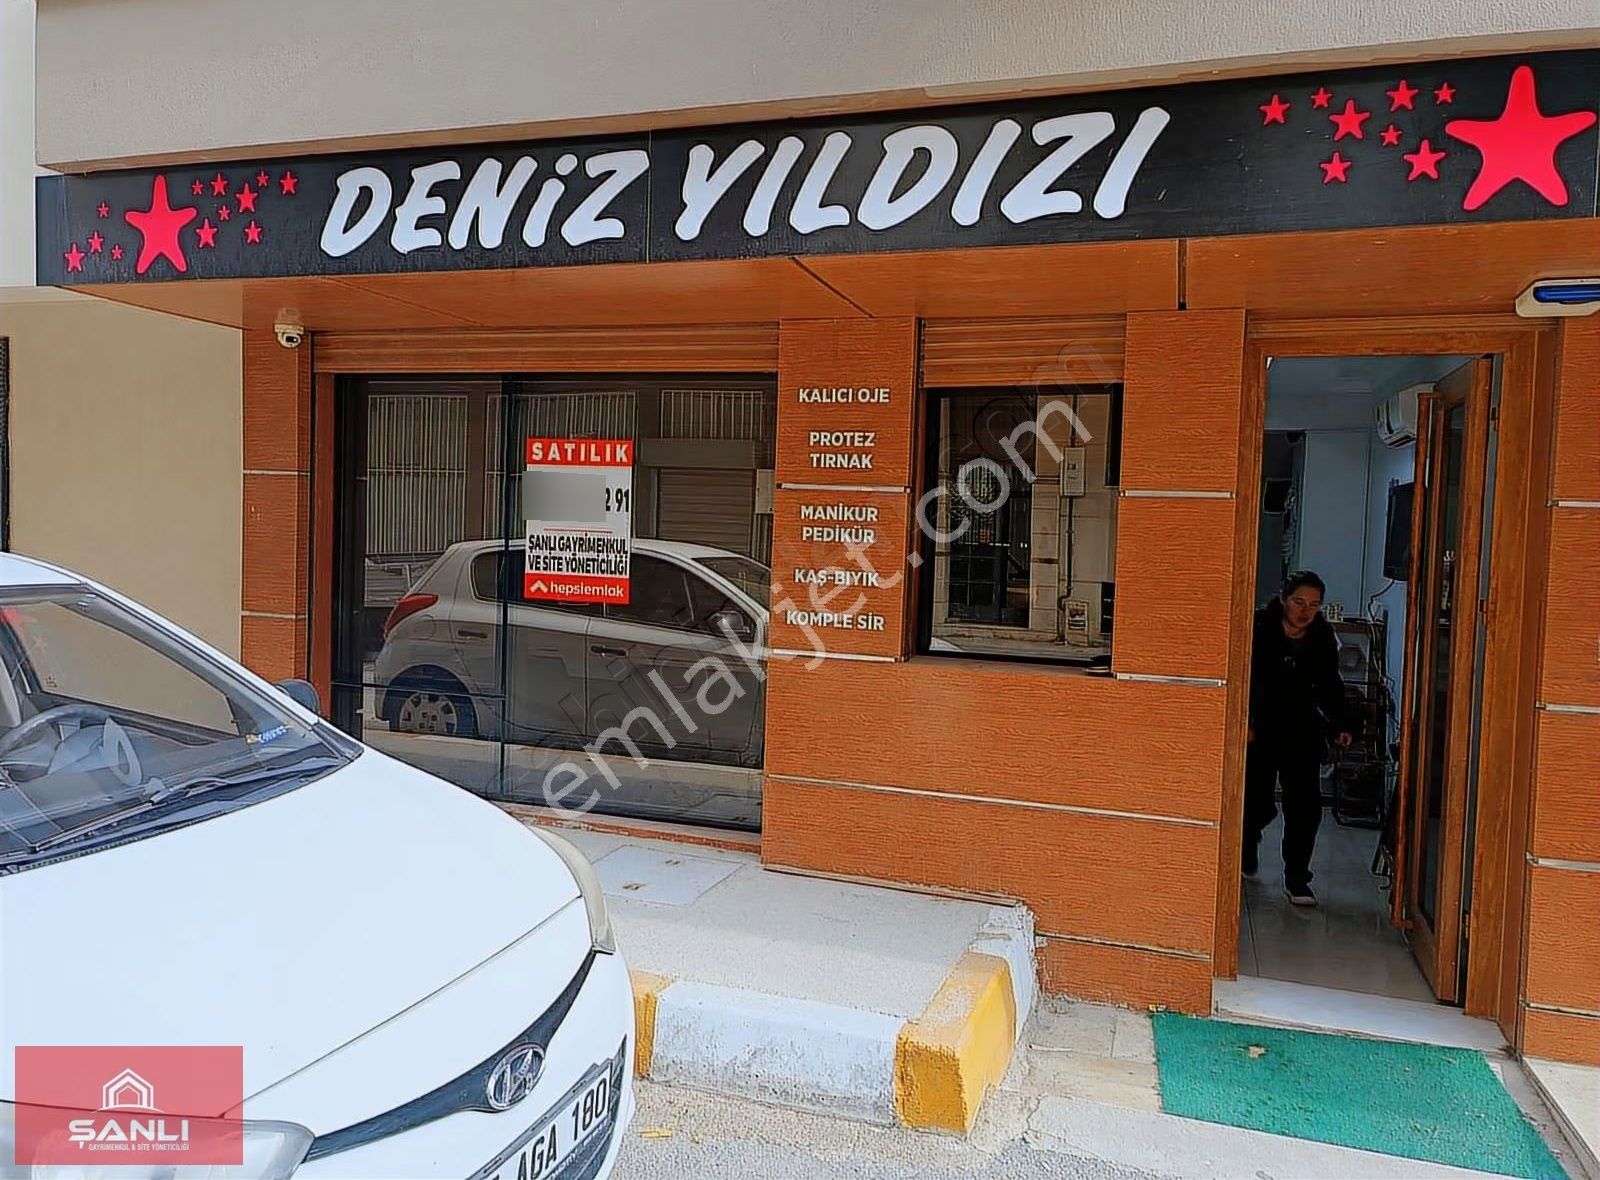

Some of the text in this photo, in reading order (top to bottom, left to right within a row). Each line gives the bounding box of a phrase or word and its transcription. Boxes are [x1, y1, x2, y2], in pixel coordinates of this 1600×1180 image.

[674, 106, 1170, 240] YILDIZI
[799, 388, 890, 403] KALICI OJE
[809, 431, 875, 447] PROTEZ
[532, 442, 628, 462] SATILIK
[810, 453, 873, 469] TIRNAK
[615, 488, 629, 512] 91
[801, 503, 878, 521] MANİKUR
[529, 533, 628, 554] ŞANLI GAYRİMENKUL
[802, 525, 875, 543] PEDİKÜR
[528, 552, 627, 575] VE SİTE YÖNETİCİLİĞİ
[795, 568, 879, 586] KAŞ-BIYIK
[551, 581, 624, 597] hepsiemlak
[786, 610, 884, 630] KOMPLE SİR
[517, 1124, 558, 1180] AGA
[571, 1077, 607, 1141] 180
